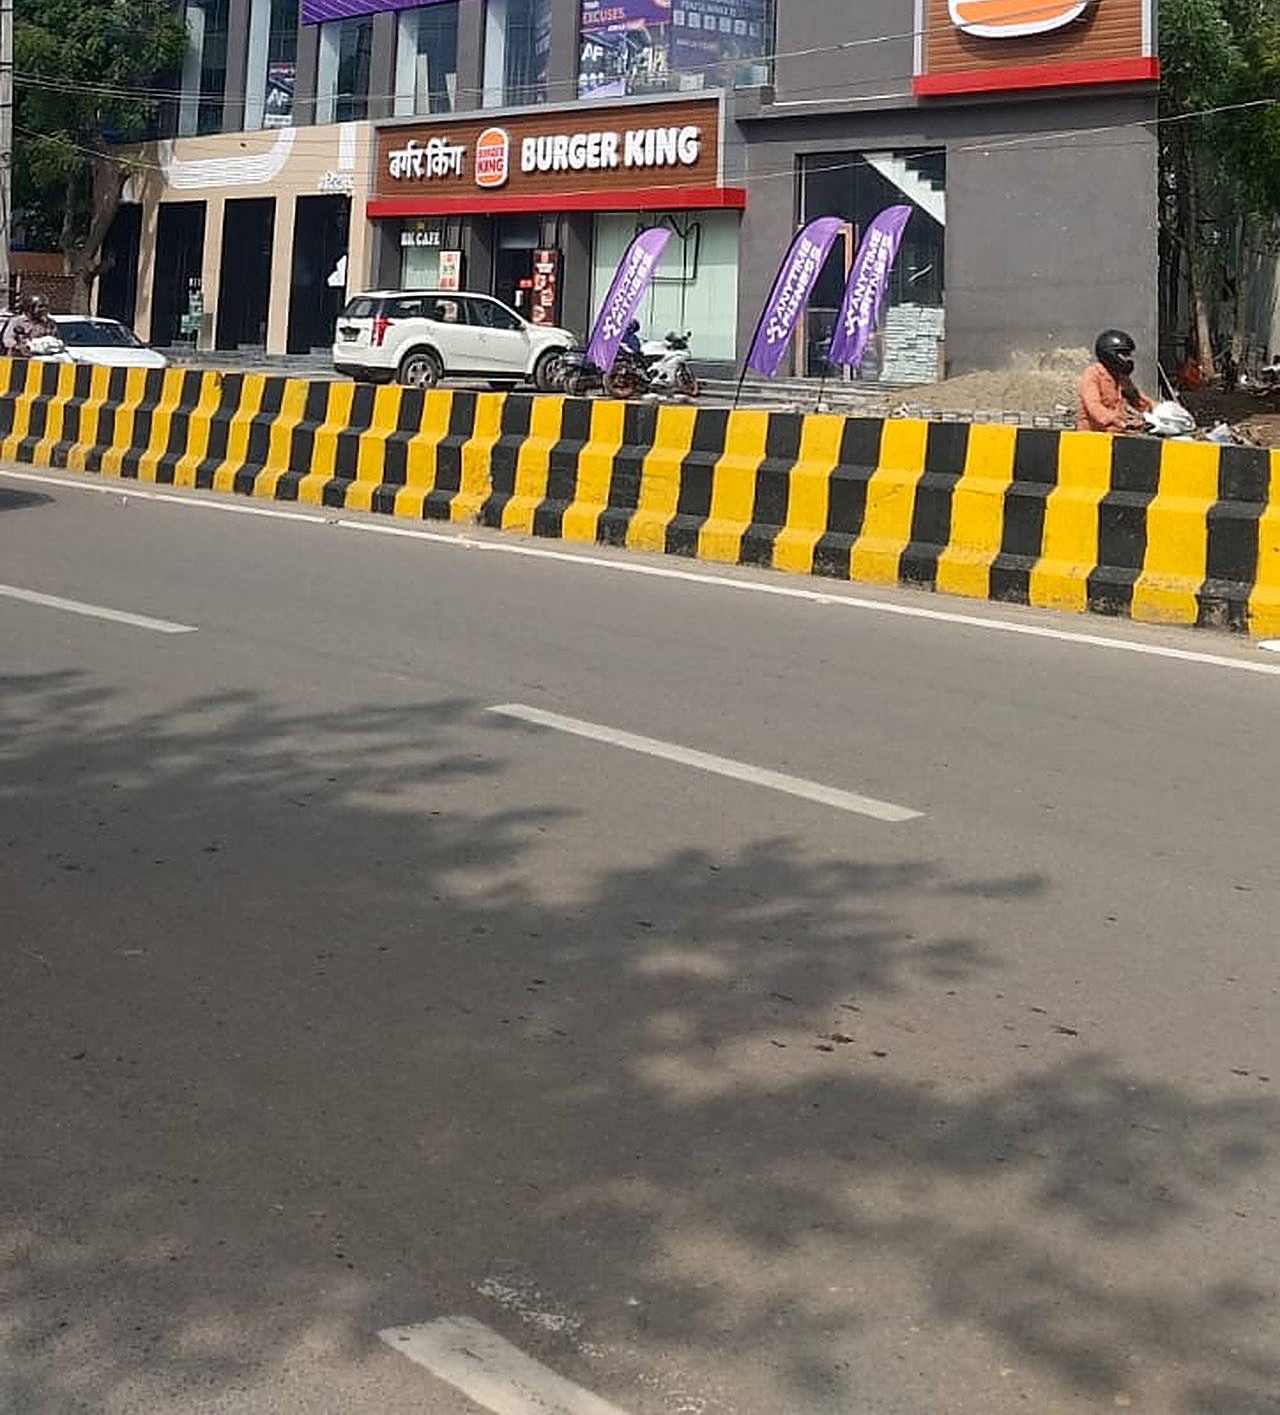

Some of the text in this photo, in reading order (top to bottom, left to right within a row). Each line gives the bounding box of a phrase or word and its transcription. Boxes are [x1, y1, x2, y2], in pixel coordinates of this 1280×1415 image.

[581, 43, 605, 62] AF
[388, 136, 466, 179] बर्गर किंग
[478, 157, 505, 174] KING
[521, 125, 699, 172] BURGER KING
[611, 246, 645, 320] ANYTIME
[616, 252, 655, 327] FITNESS
[776, 237, 812, 320] ANYTIME
[782, 245, 820, 328] FITNESS
[851, 227, 882, 310] ANYTIME
[859, 231, 893, 327] FITNESS
